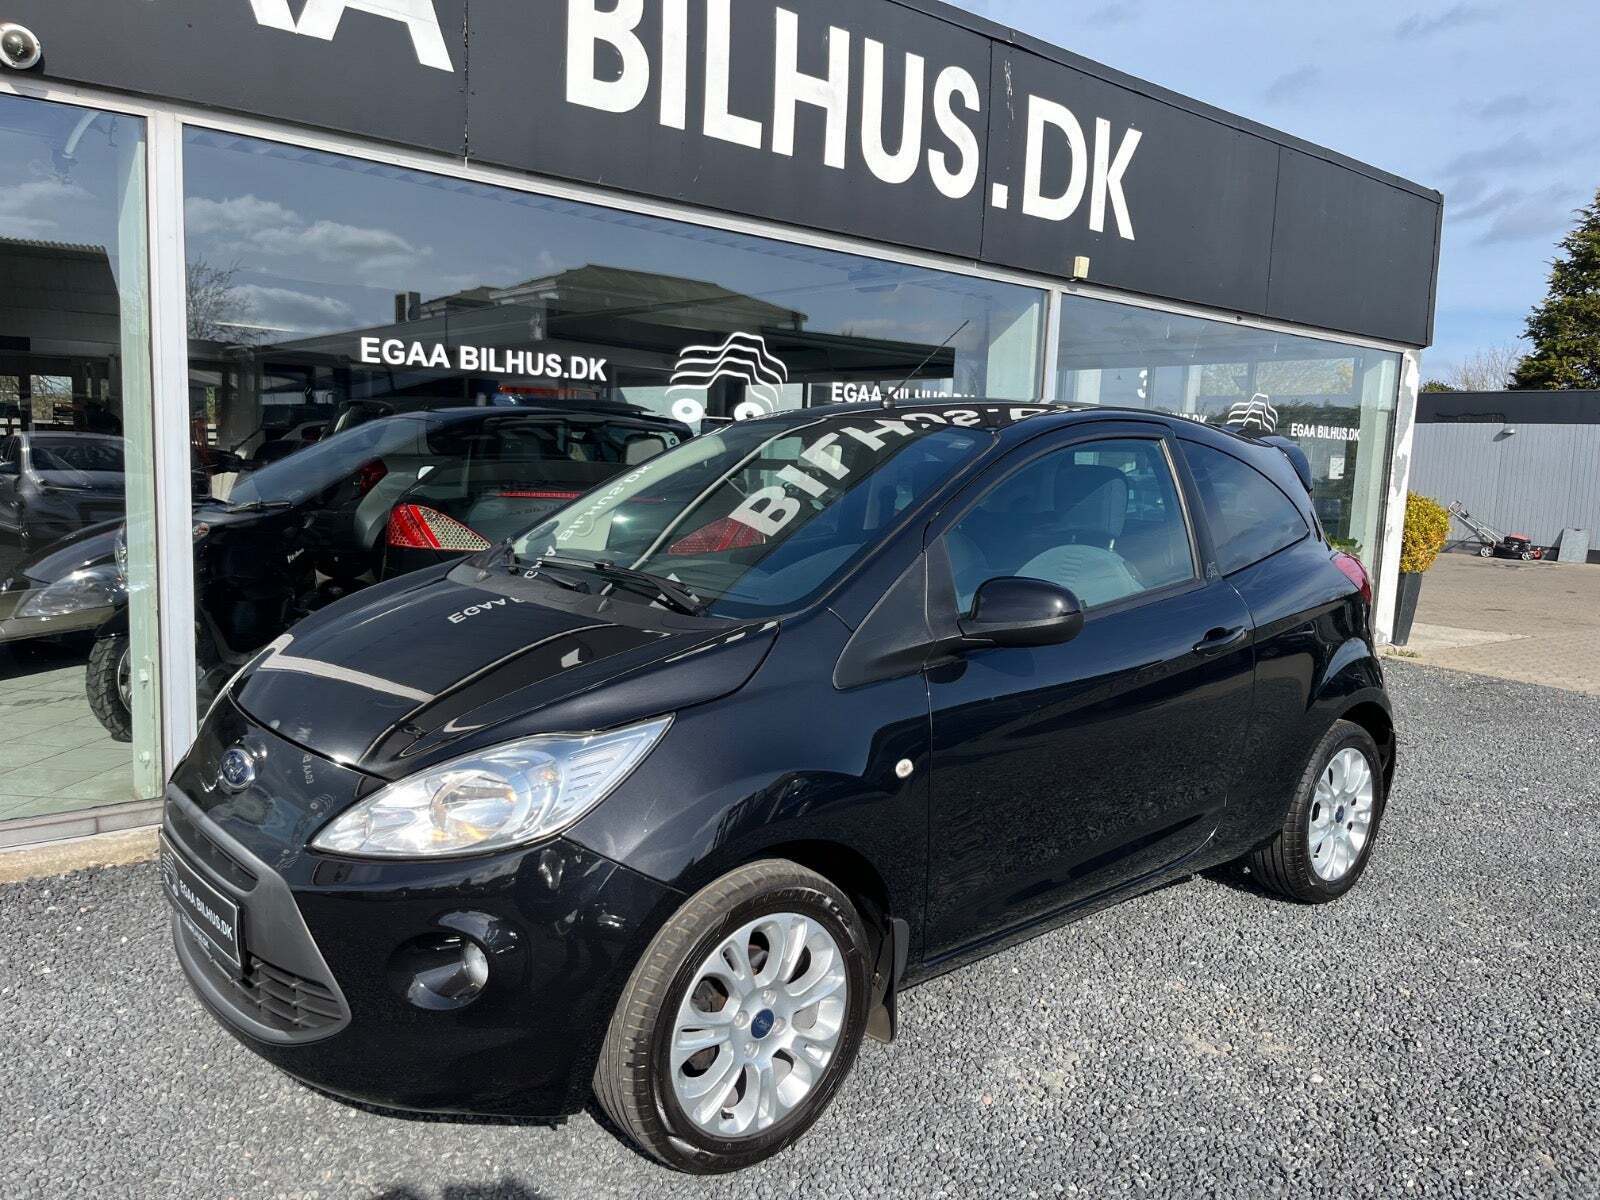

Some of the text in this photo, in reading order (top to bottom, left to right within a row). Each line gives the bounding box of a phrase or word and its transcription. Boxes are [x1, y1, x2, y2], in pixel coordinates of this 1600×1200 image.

[566, 0, 1142, 240] BILHUS.DK
[360, 337, 607, 381] EGAA BILHUS.DK
[832, 382, 882, 403] EGAA
[1290, 423, 1360, 441] EGAA BILHUS.DK
[180, 879, 196, 907] EGAA
[196, 897, 232, 941] BILHUS.DK
